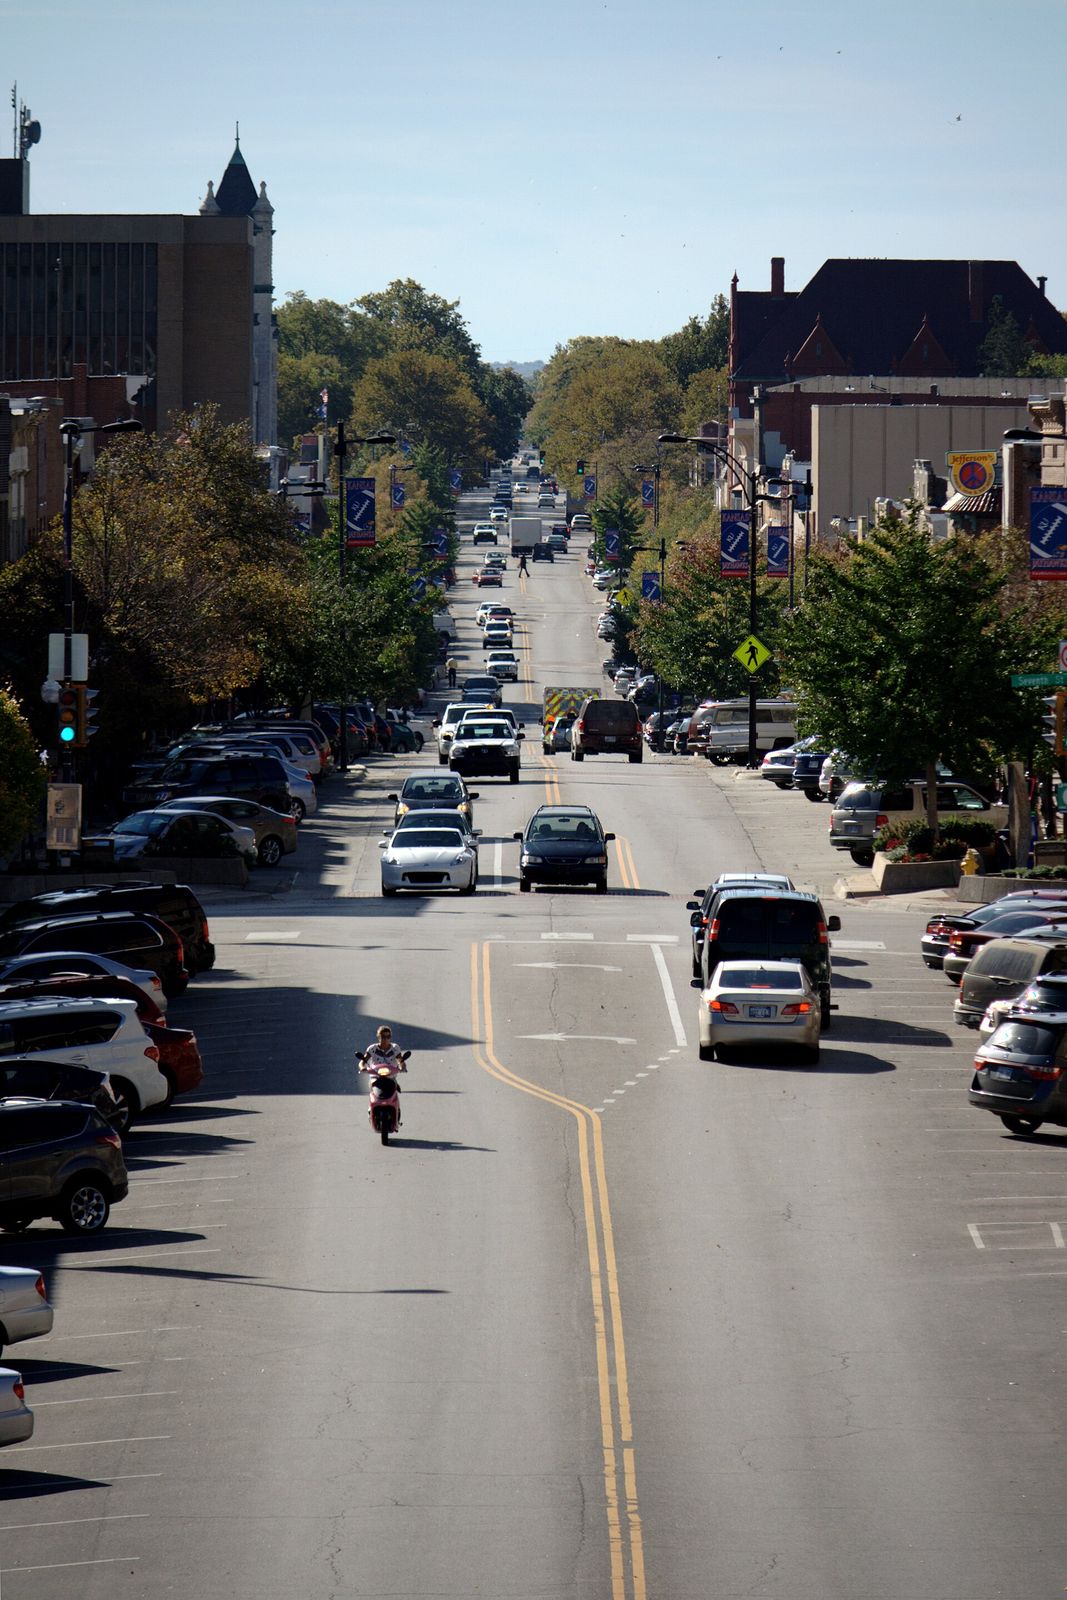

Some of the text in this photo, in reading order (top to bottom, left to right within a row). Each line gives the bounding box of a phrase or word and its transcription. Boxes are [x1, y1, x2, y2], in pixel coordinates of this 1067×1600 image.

[952, 454, 994, 464] Jefferson's
[722, 512, 749, 522] KANSAS
[1018, 675, 1064, 685] Seventh St
